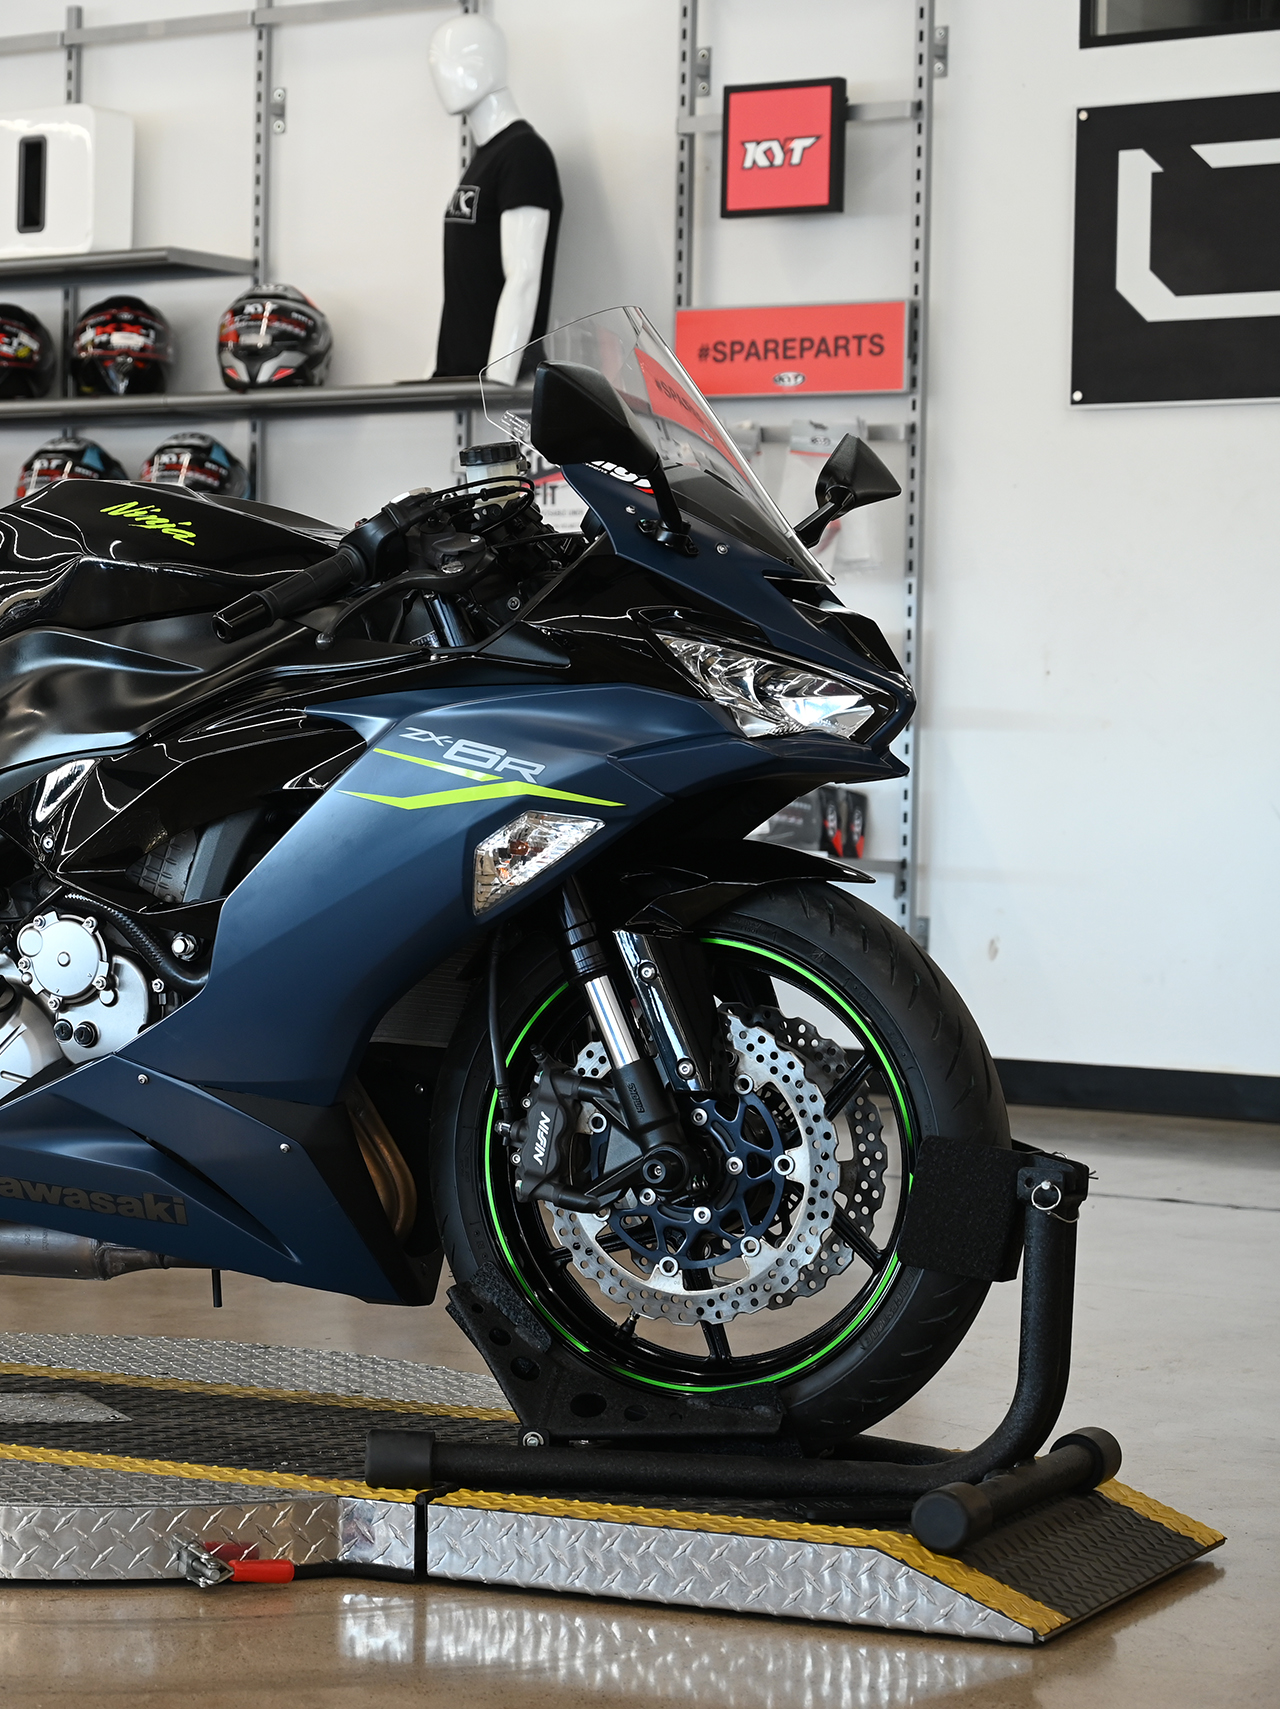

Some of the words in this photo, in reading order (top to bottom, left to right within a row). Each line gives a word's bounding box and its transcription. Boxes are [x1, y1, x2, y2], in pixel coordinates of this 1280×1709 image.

[740, 135, 822, 169] KYT
[698, 333, 886, 364] #SPAREPARTS
[99, 500, 197, 546] Ninja
[398, 726, 546, 785] ZX-6R
